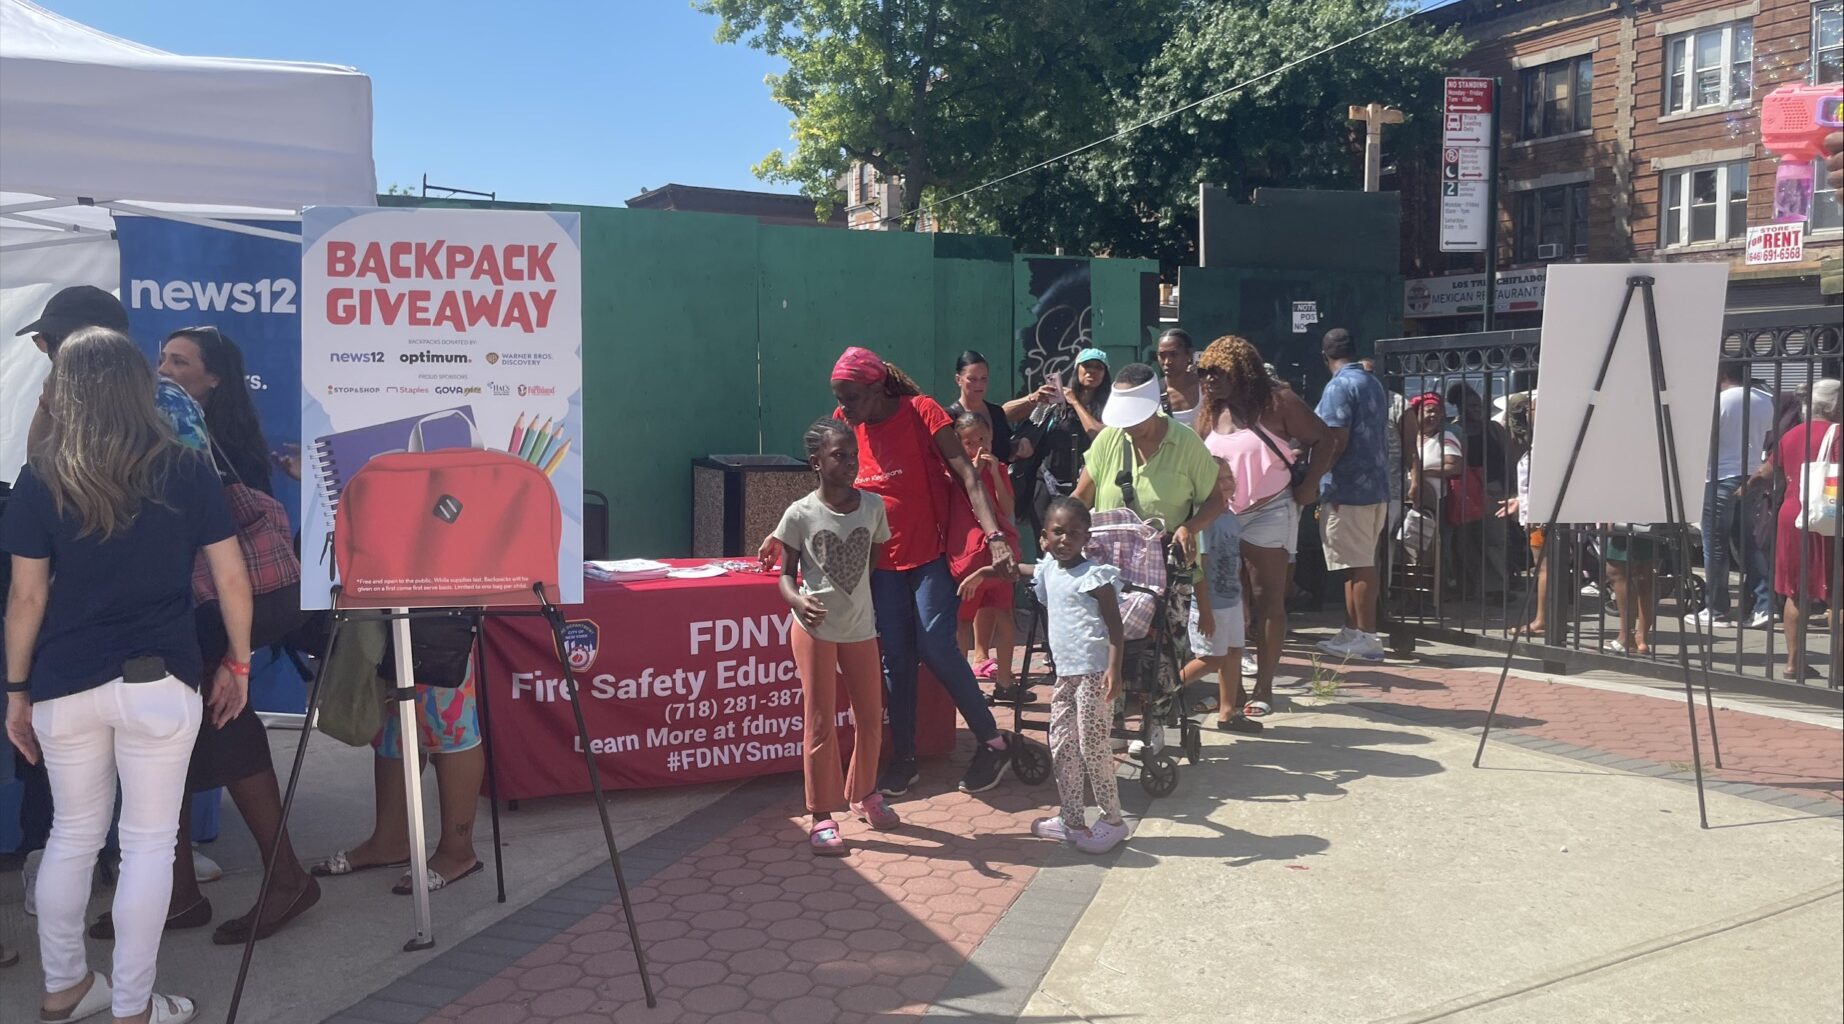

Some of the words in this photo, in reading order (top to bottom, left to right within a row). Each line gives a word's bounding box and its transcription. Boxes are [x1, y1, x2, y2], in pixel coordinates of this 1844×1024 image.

[1446, 182, 1455, 195] 2
[1760, 226, 1790, 234] STORE
[1763, 230, 1801, 249] RENT
[1763, 247, 1801, 262] 691-6568
[326, 240, 558, 286] BACKPACK
[1452, 281, 1468, 289] LOS
[131, 278, 296, 314] news12
[1432, 292, 1474, 304] MEXICAN
[326, 287, 558, 333] GIVEAWAY
[330, 351, 385, 363] news12
[400, 386, 429, 395] Staples
[434, 386, 463, 395] GOYA
[484, 576, 511, 584] Backpacks
[690, 613, 793, 655] FDNY
[511, 670, 579, 703] Fire
[591, 667, 706, 701] Safety
[664, 699, 718, 724] (718)
[723, 688, 803, 716] 281-387
[574, 732, 640, 754] Learn
[647, 727, 707, 749] More
[714, 720, 736, 740] at
